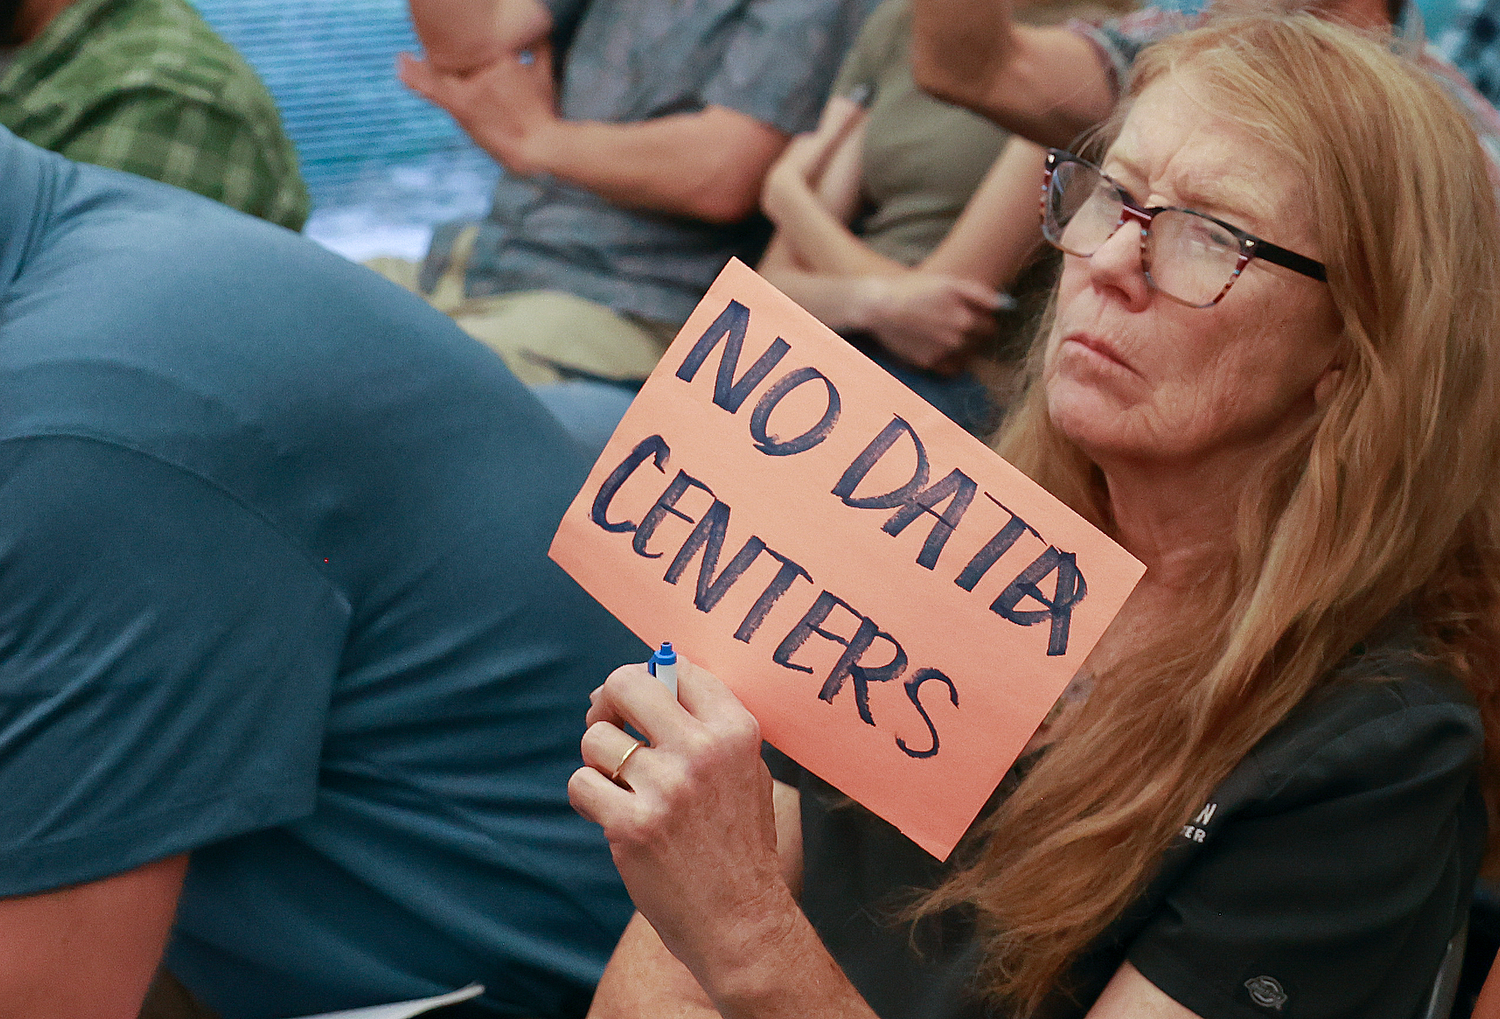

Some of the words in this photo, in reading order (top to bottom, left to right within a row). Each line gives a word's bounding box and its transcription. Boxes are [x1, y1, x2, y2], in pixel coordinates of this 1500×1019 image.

[588, 434, 959, 759] CENTERS
[675, 299, 841, 456] NO
[831, 413, 1087, 656] DATA
